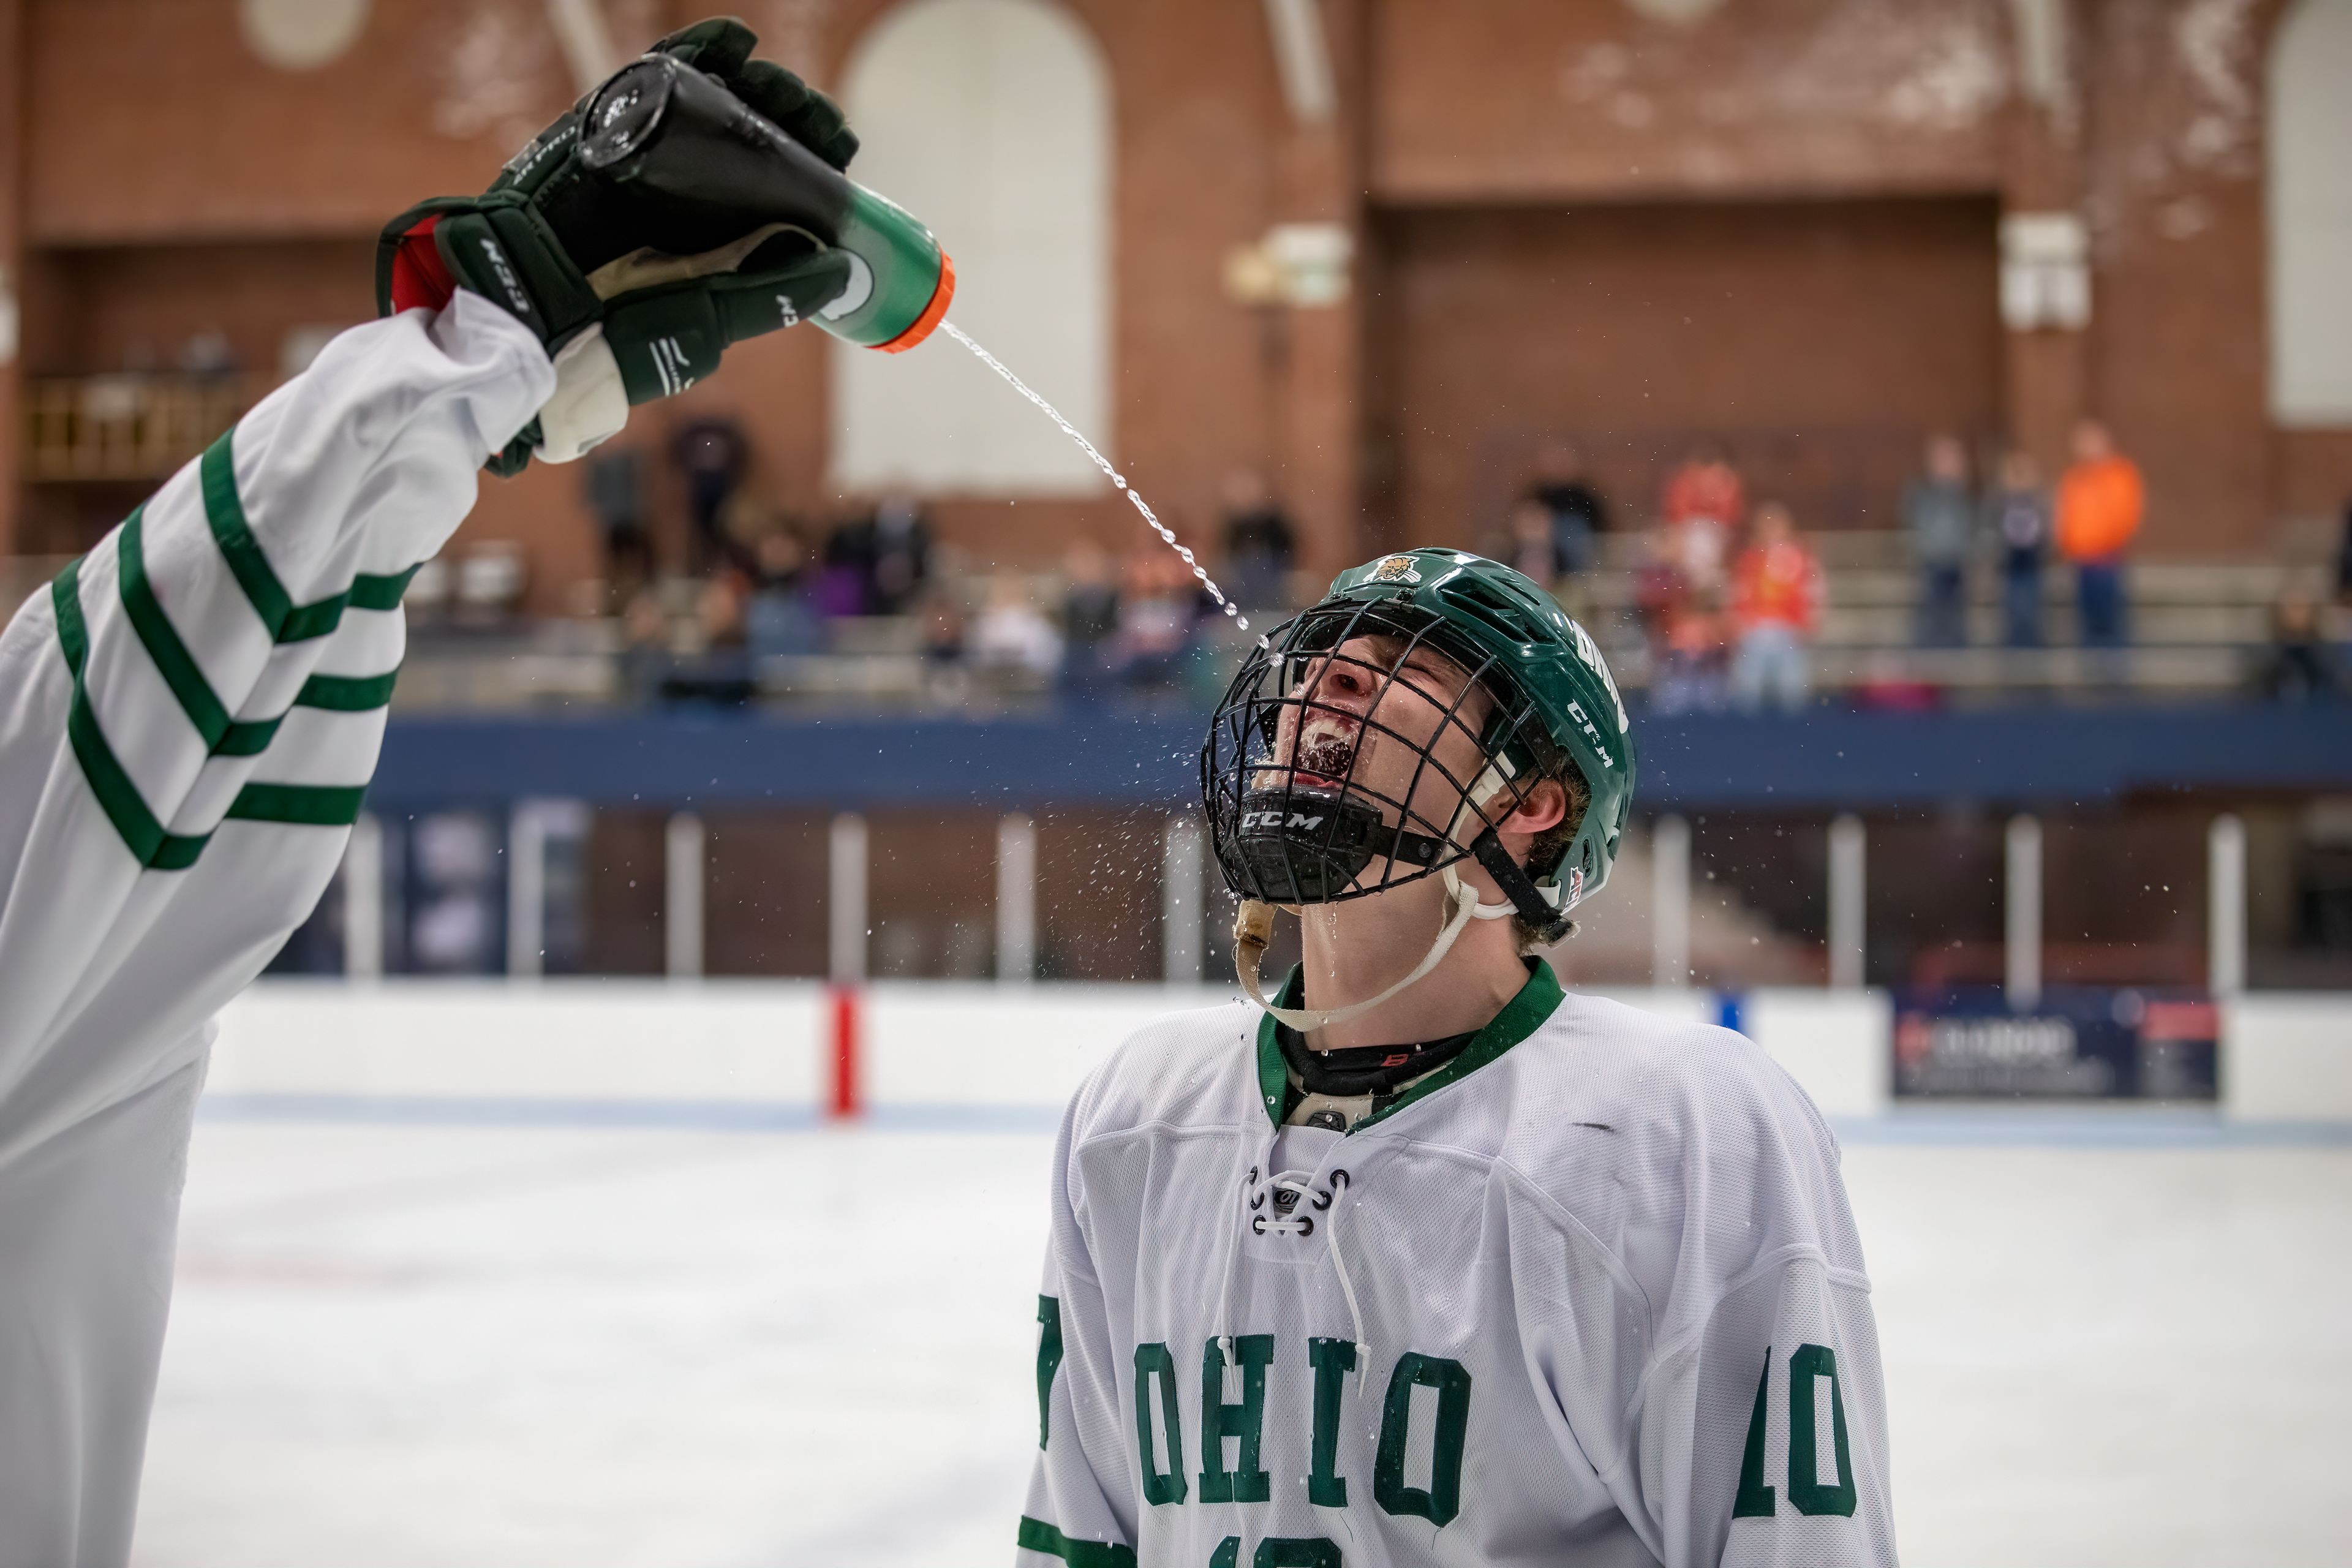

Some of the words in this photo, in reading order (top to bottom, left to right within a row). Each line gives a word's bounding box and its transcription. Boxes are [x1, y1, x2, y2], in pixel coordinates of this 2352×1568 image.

[480, 239, 530, 313] CCM
[1242, 811, 1324, 831] CCM
[1134, 1333, 1472, 1528] OHIO
